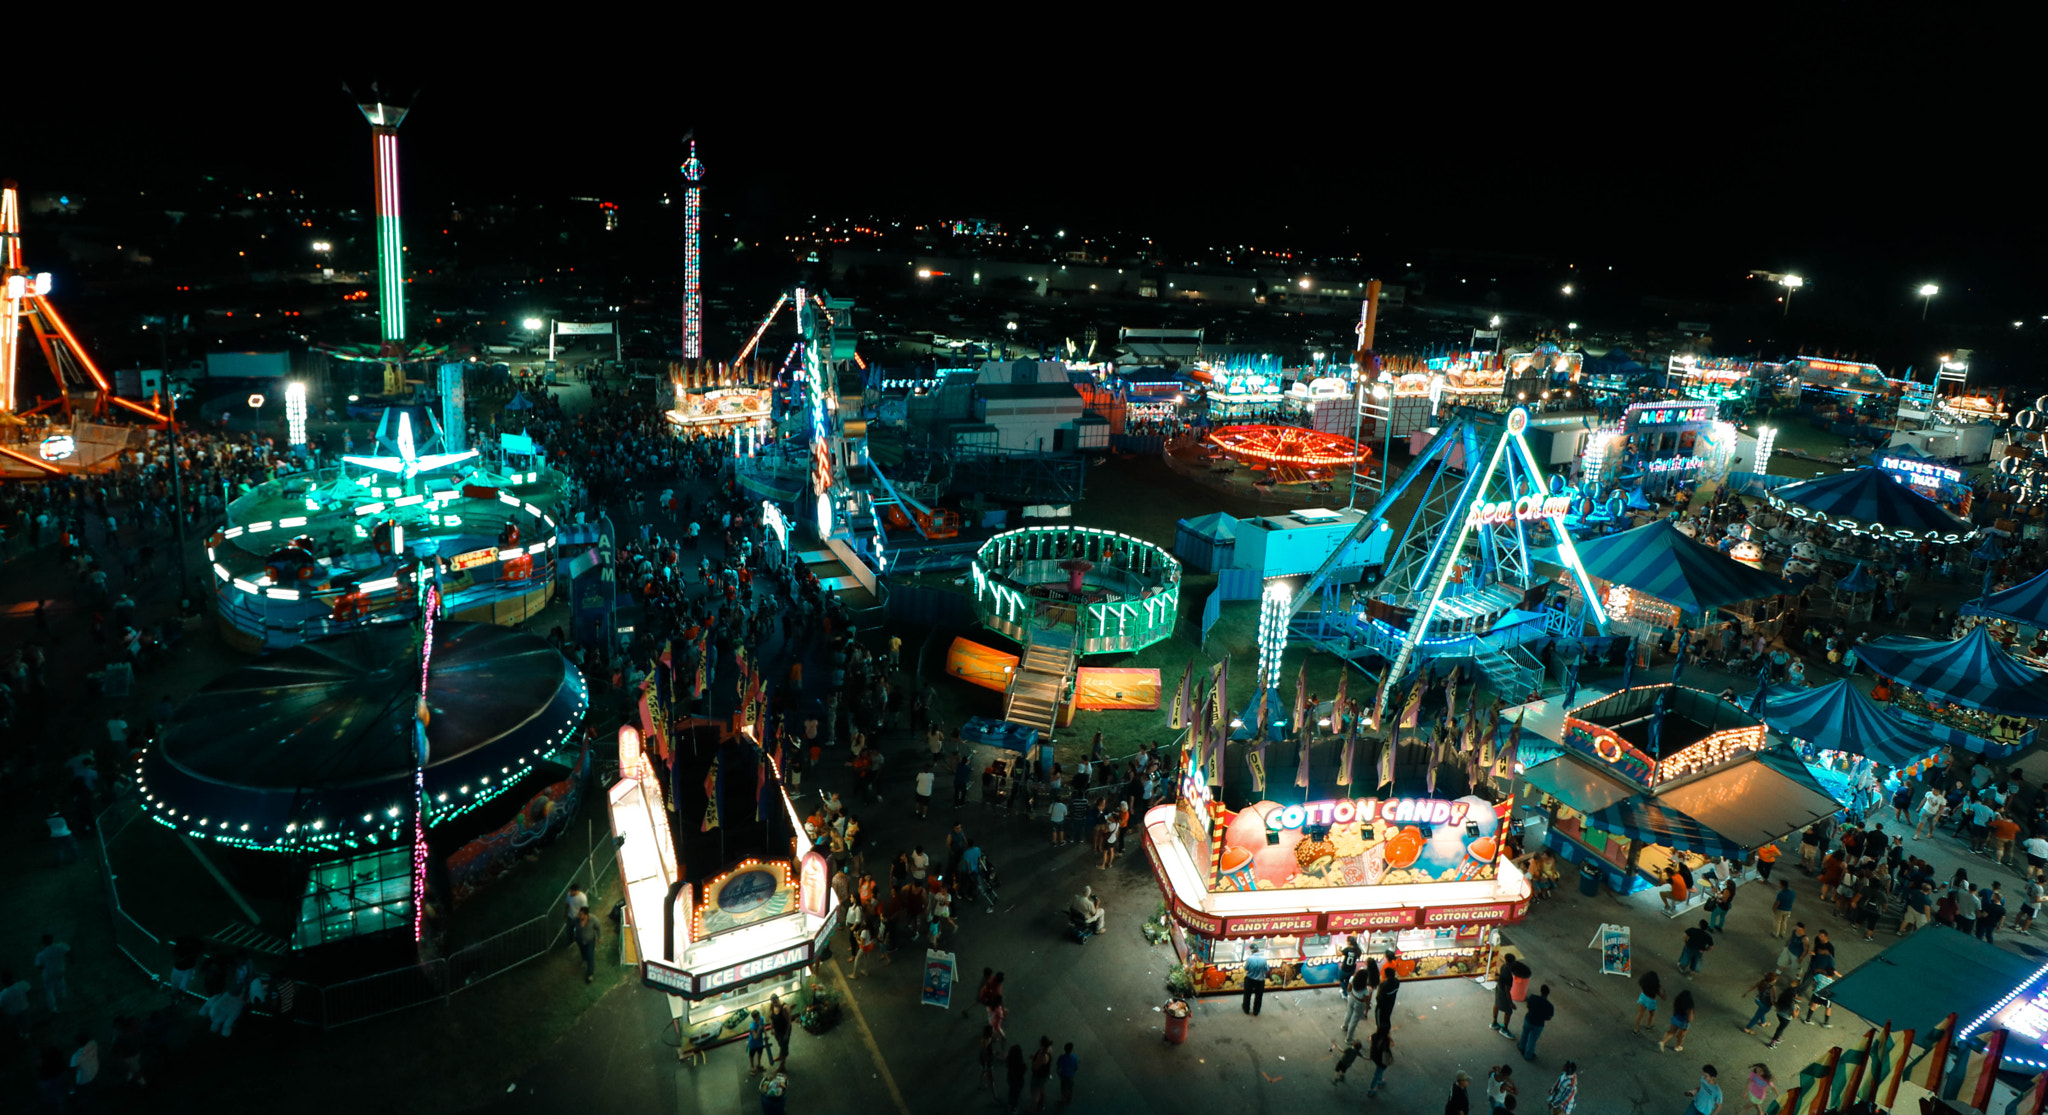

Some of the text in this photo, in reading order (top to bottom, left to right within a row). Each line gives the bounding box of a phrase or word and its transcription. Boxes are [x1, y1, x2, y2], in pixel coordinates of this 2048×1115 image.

[1638, 408, 1707, 424] MAGIC MAZE
[1881, 457, 1961, 482] MONSTER
[1910, 472, 1941, 488] TRUCK
[1466, 499, 1512, 525] Sea
[598, 533, 615, 582] ATM
[1084, 677, 1113, 686] Zero
[1266, 798, 1470, 831] COTTON CANDY
[1231, 866, 1257, 888] ICEE
[1176, 906, 1216, 932] DRINKS
[1230, 920, 1312, 932] CANDY APPLES
[1343, 915, 1399, 926] POP CORN
[1429, 910, 1505, 921] COTTON CANDY
[1401, 947, 1476, 961] CANDY APPLES
[706, 947, 803, 989] ICE CREAM
[648, 972, 693, 993] DRINKS
